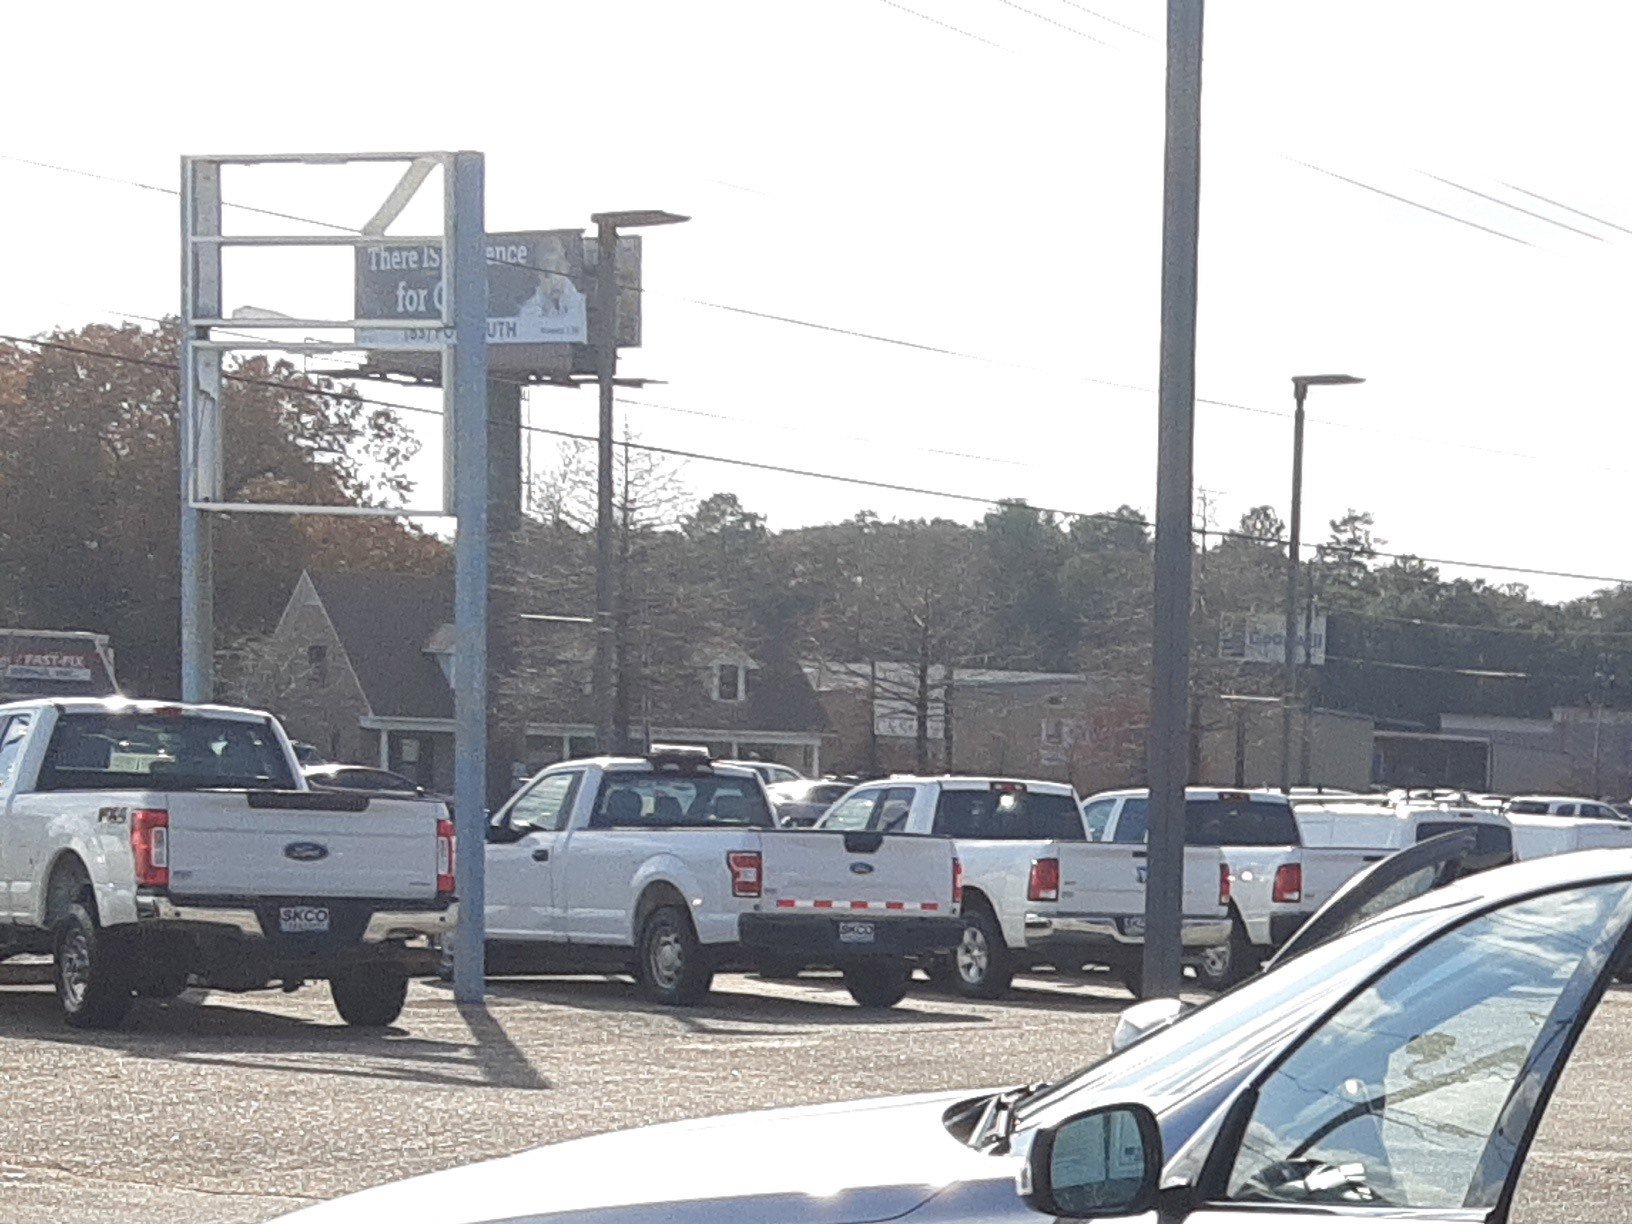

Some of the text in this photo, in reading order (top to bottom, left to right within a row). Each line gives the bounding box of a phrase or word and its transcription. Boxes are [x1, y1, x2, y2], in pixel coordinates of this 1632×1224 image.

[368, 243, 419, 271] There
[396, 280, 428, 312] for
[281, 909, 328, 922] SKCO
